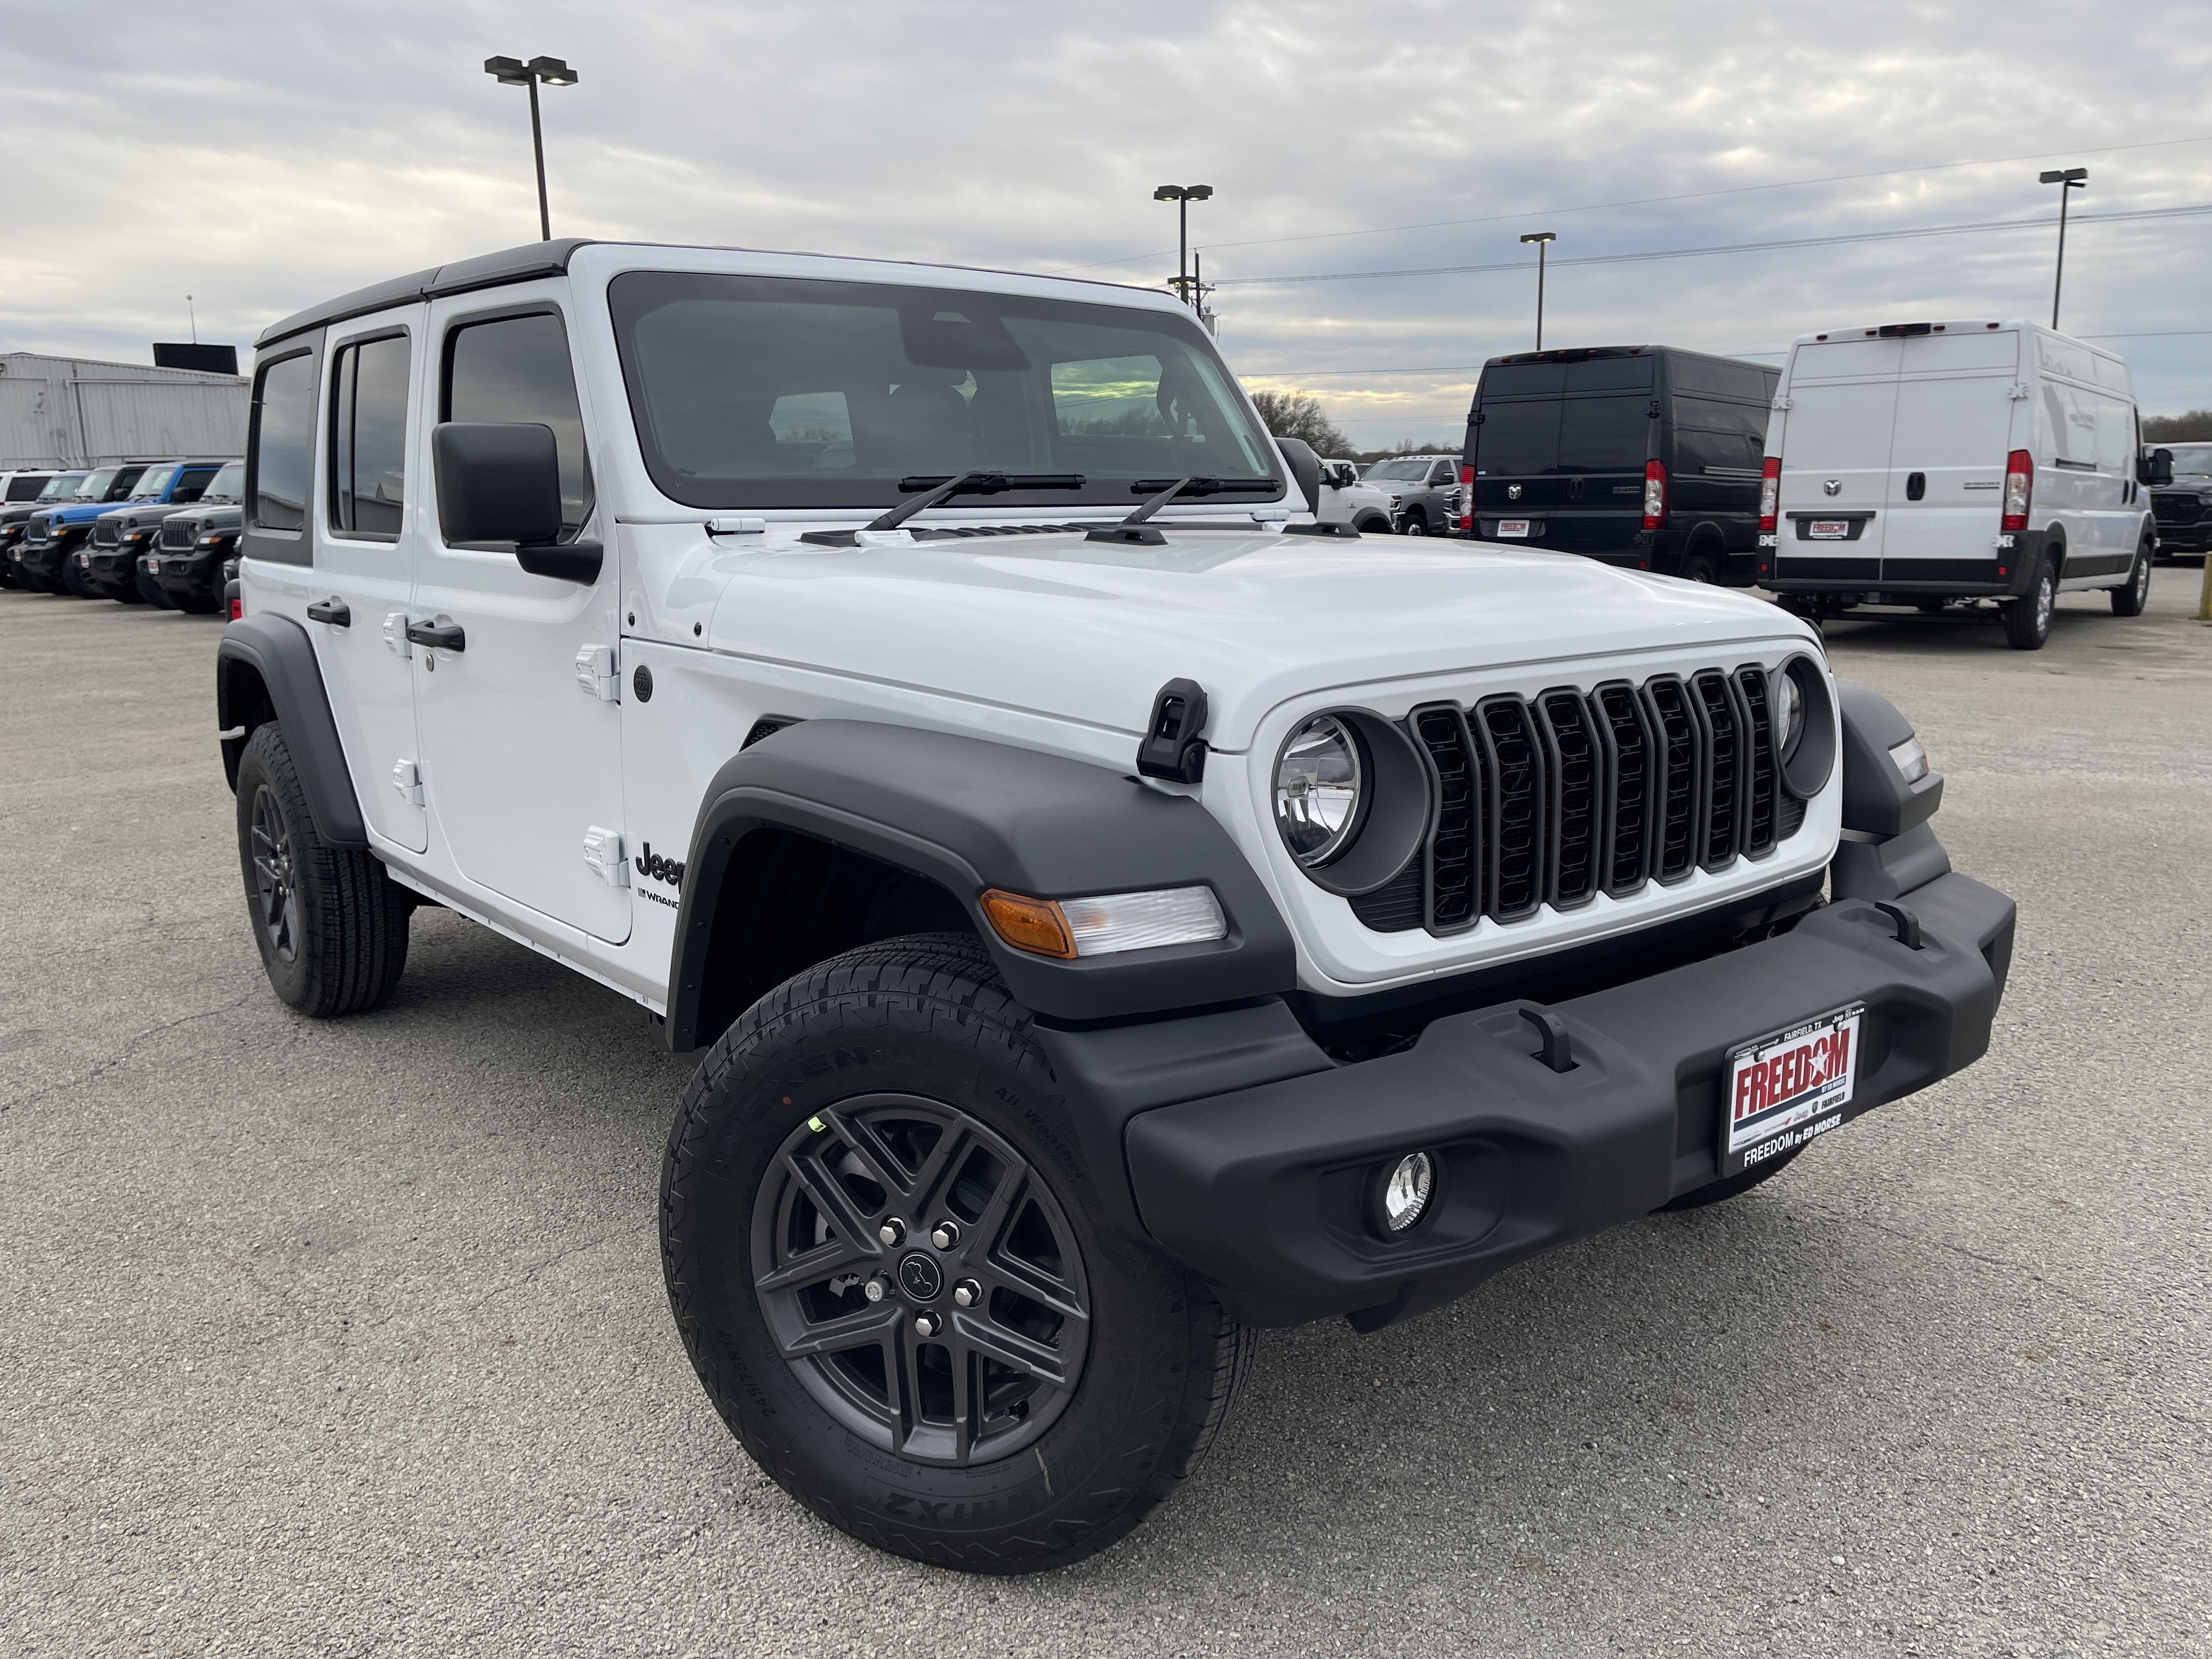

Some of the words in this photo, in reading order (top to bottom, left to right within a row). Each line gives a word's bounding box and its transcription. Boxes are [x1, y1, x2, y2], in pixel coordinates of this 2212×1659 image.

[1814, 1020, 1822, 1031] TX
[1734, 1027, 1850, 1120] FREEDOM
[1744, 1131, 1794, 1167] FREEDOM
[1803, 1125, 1814, 1141] ED
[1814, 1113, 1842, 1136] MORSE
